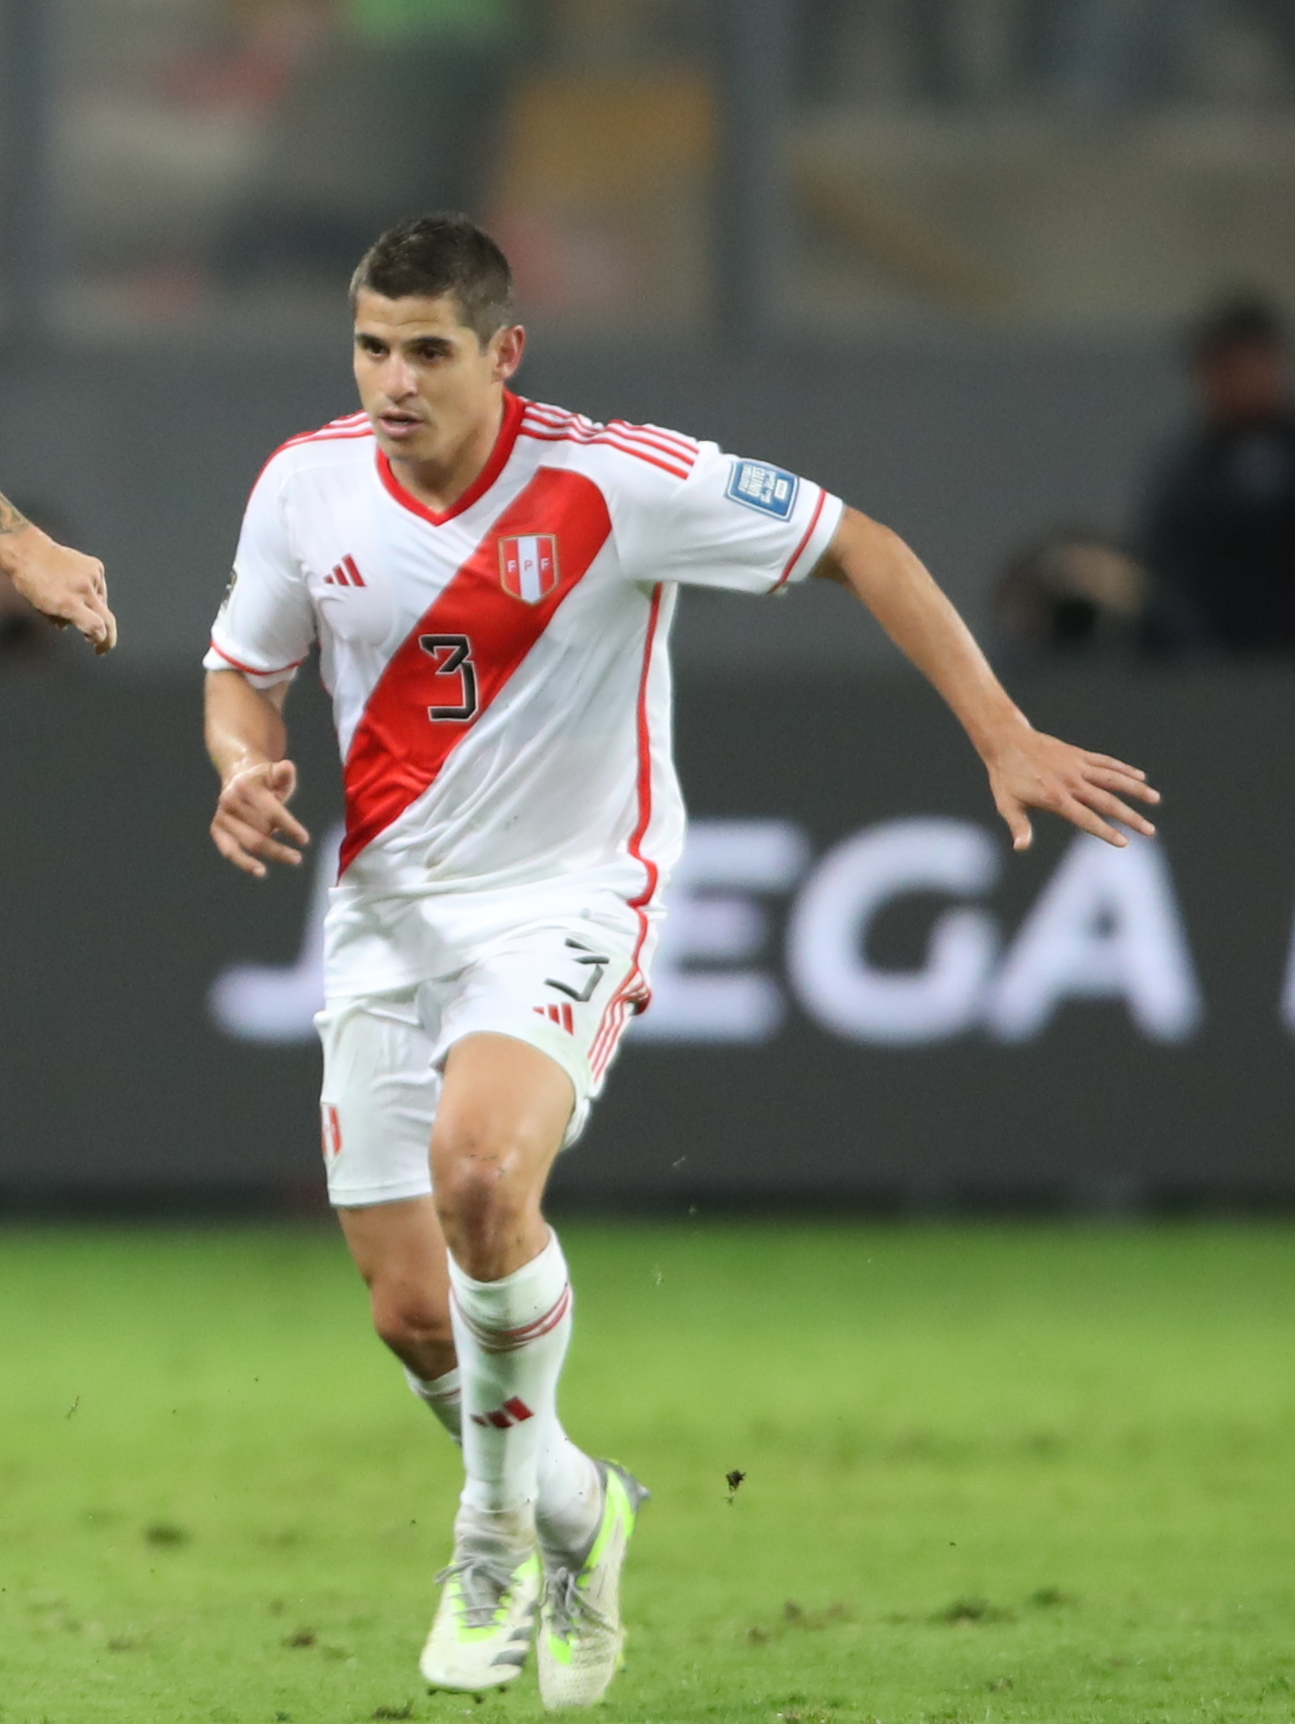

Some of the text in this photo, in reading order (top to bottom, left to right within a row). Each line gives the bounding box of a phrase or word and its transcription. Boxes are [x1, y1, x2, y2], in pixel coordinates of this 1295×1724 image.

[419, 634, 479, 722] 3
[209, 814, 1202, 1044] JEGA
[544, 937, 610, 1002] 3
